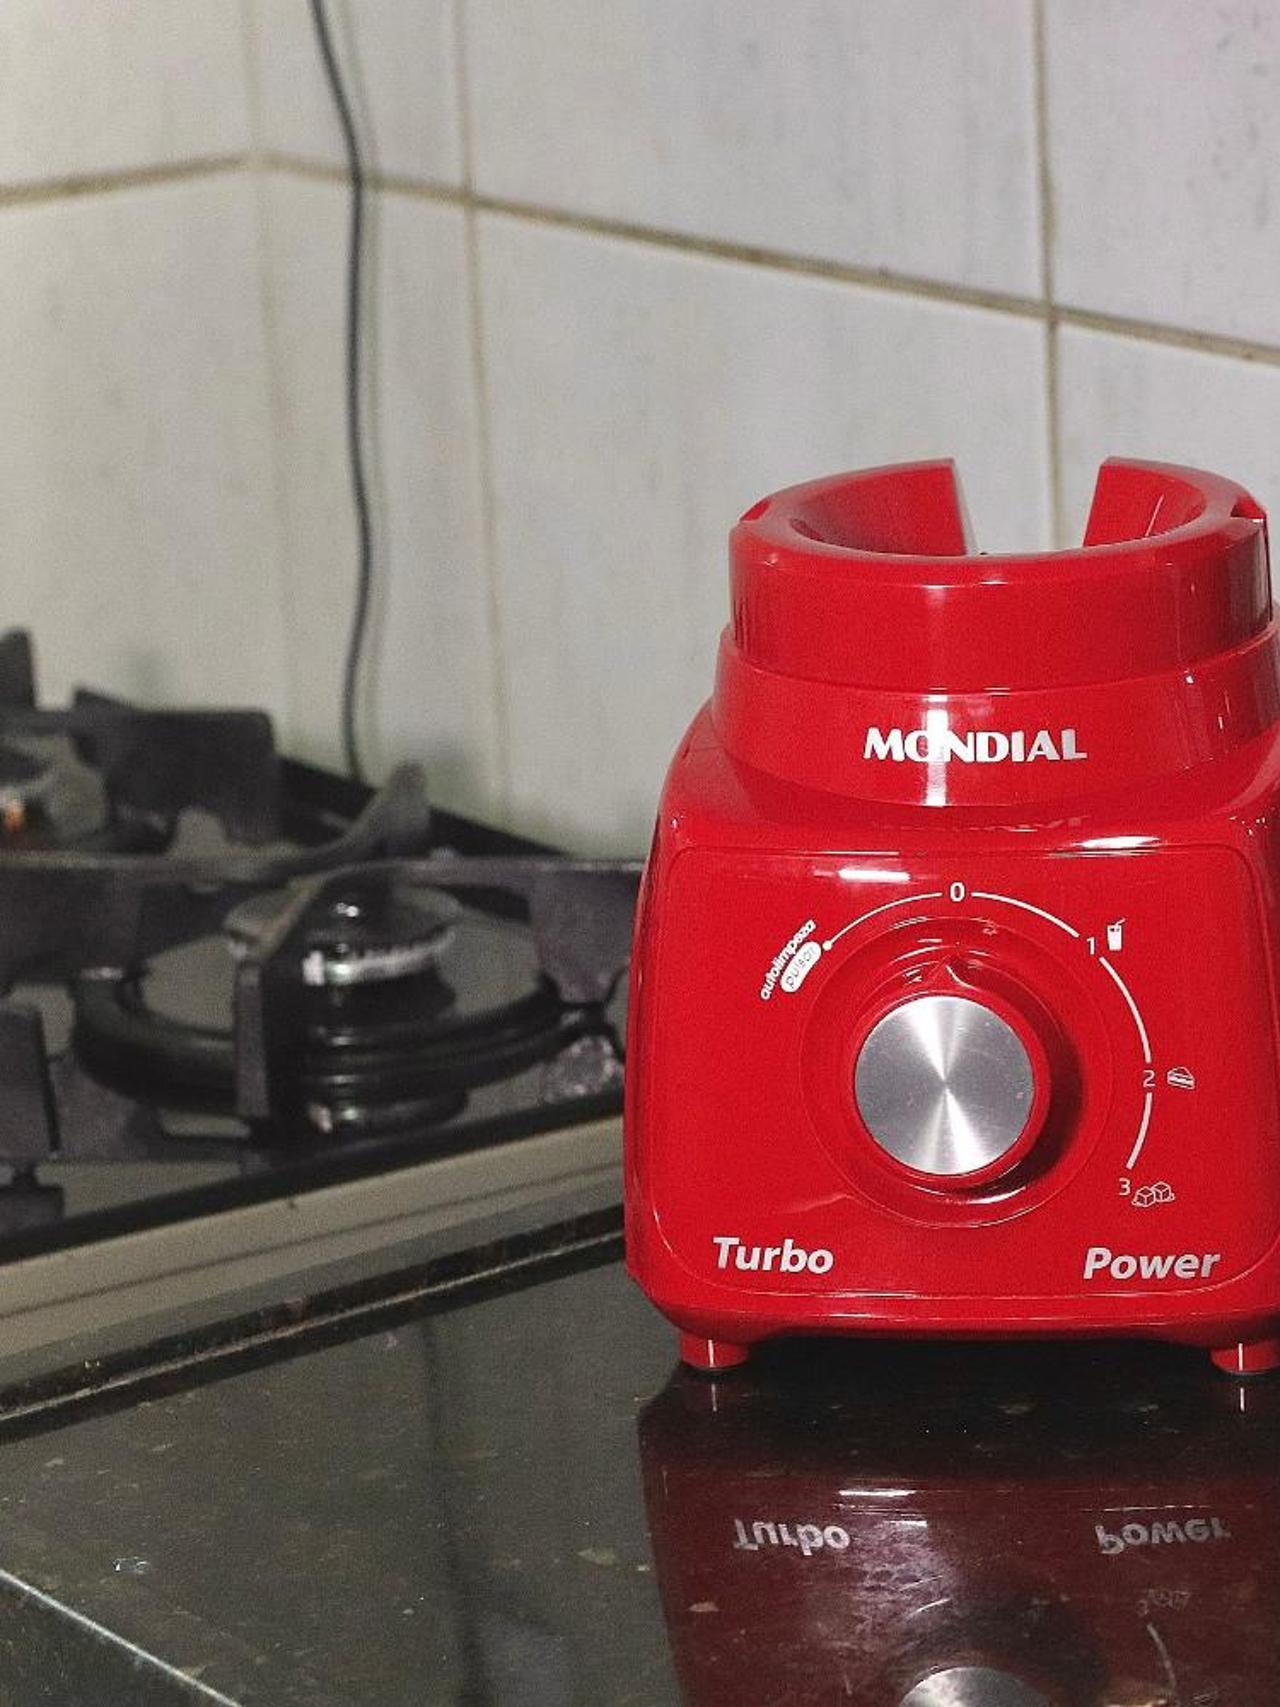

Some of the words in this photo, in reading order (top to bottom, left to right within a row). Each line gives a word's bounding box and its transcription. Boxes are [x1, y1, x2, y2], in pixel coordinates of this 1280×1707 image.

[863, 727, 1088, 763] MONDIAL
[950, 881, 965, 902] 0
[1086, 936, 1096, 956] 1
[1142, 1069, 1156, 1088] 2
[1118, 1177, 1131, 1198] 3
[714, 1236, 834, 1275] Turbo
[1083, 1247, 1221, 1281] Power
